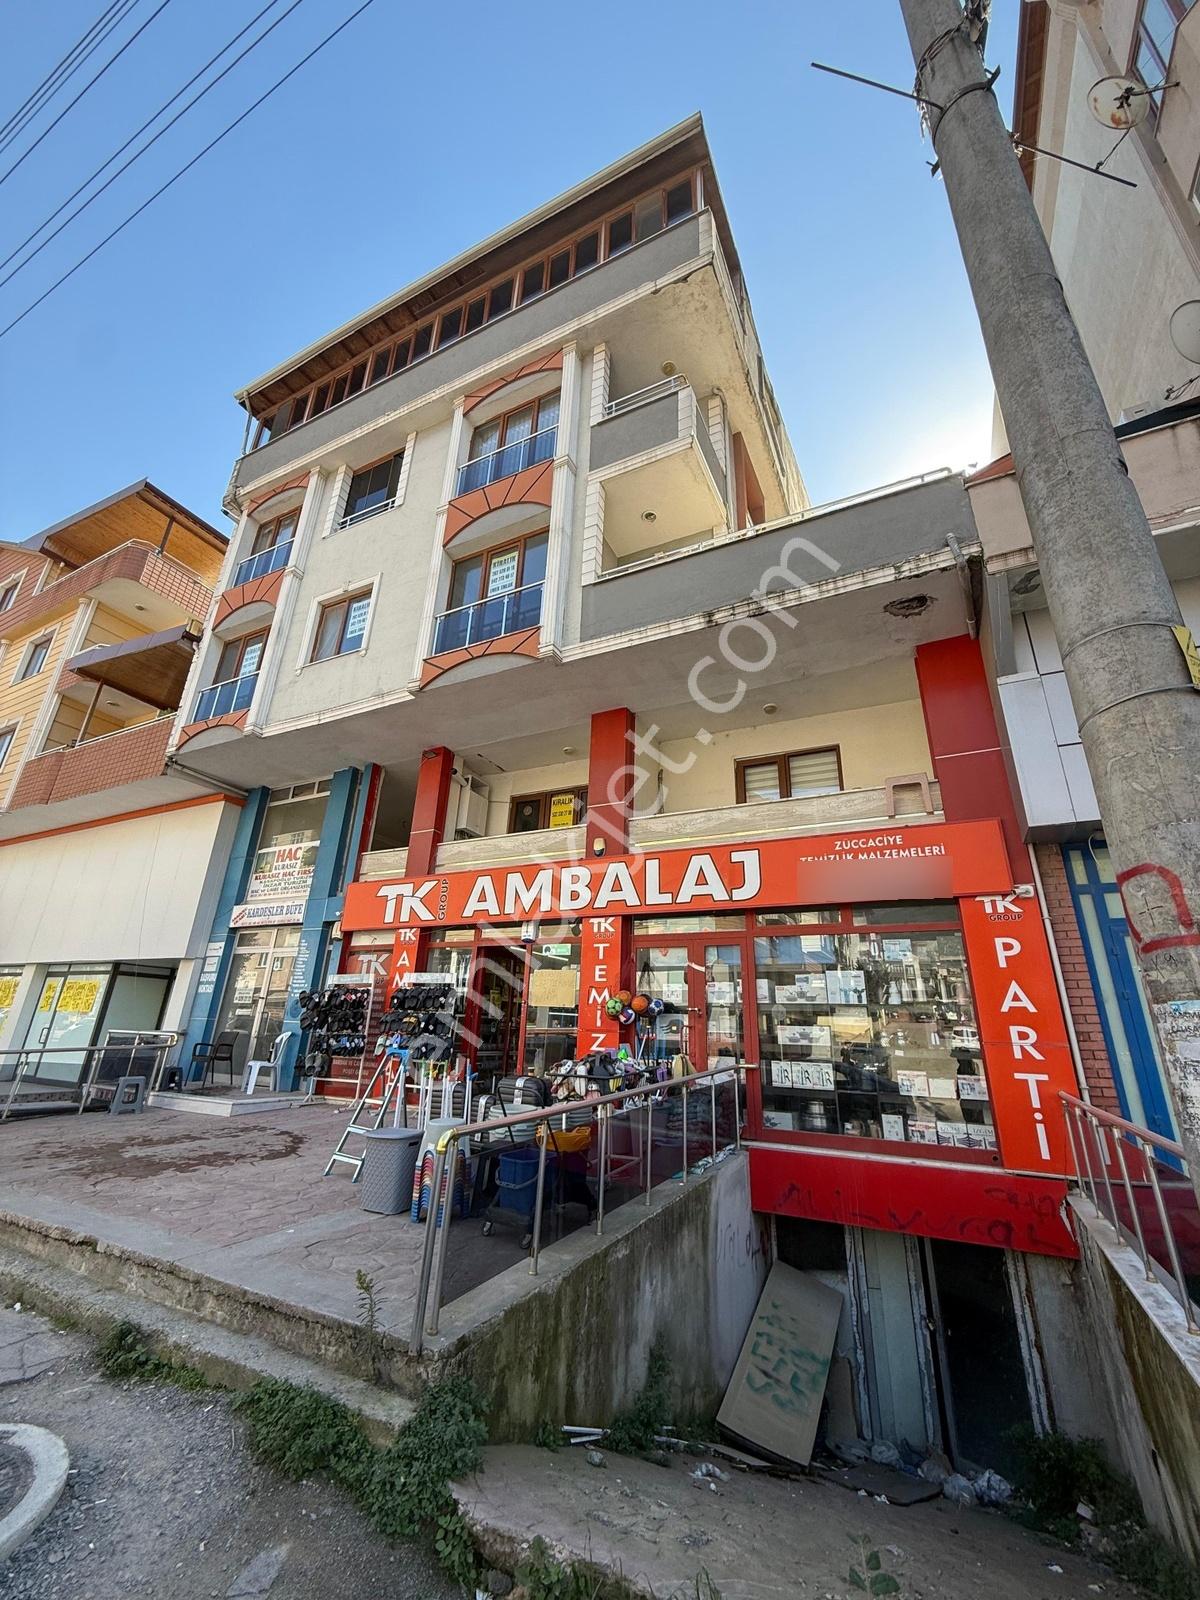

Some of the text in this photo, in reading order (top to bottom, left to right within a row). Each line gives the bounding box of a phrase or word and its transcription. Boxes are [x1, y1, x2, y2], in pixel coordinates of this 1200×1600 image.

[834, 834, 903, 851] ZÜCCACİYE
[276, 846, 303, 863] HAC
[858, 843, 946, 860] MALZEMELERİ
[376, 849, 762, 924] TK GROUP AMBALAJ
[975, 895, 1024, 914] TK
[589, 917, 616, 933] TK
[989, 914, 1024, 922] GROUP
[994, 937, 1051, 1160] PARTİ
